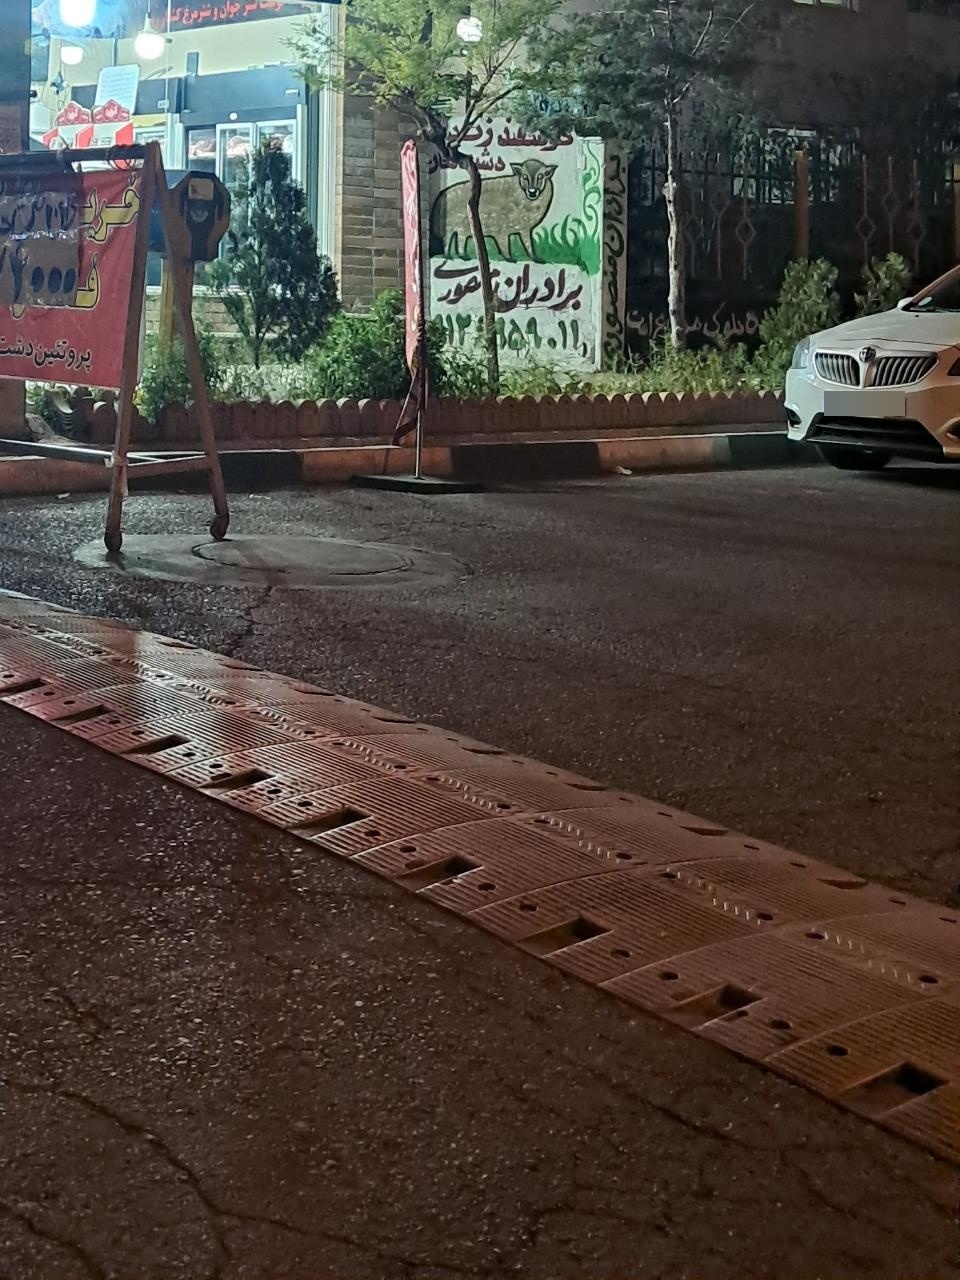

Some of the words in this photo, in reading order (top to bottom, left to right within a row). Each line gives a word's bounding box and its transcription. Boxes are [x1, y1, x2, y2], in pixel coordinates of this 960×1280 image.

[433, 260, 500, 305] مصوری
[495, 264, 583, 314] برادران
[35, 338, 92, 374] پروتئین
